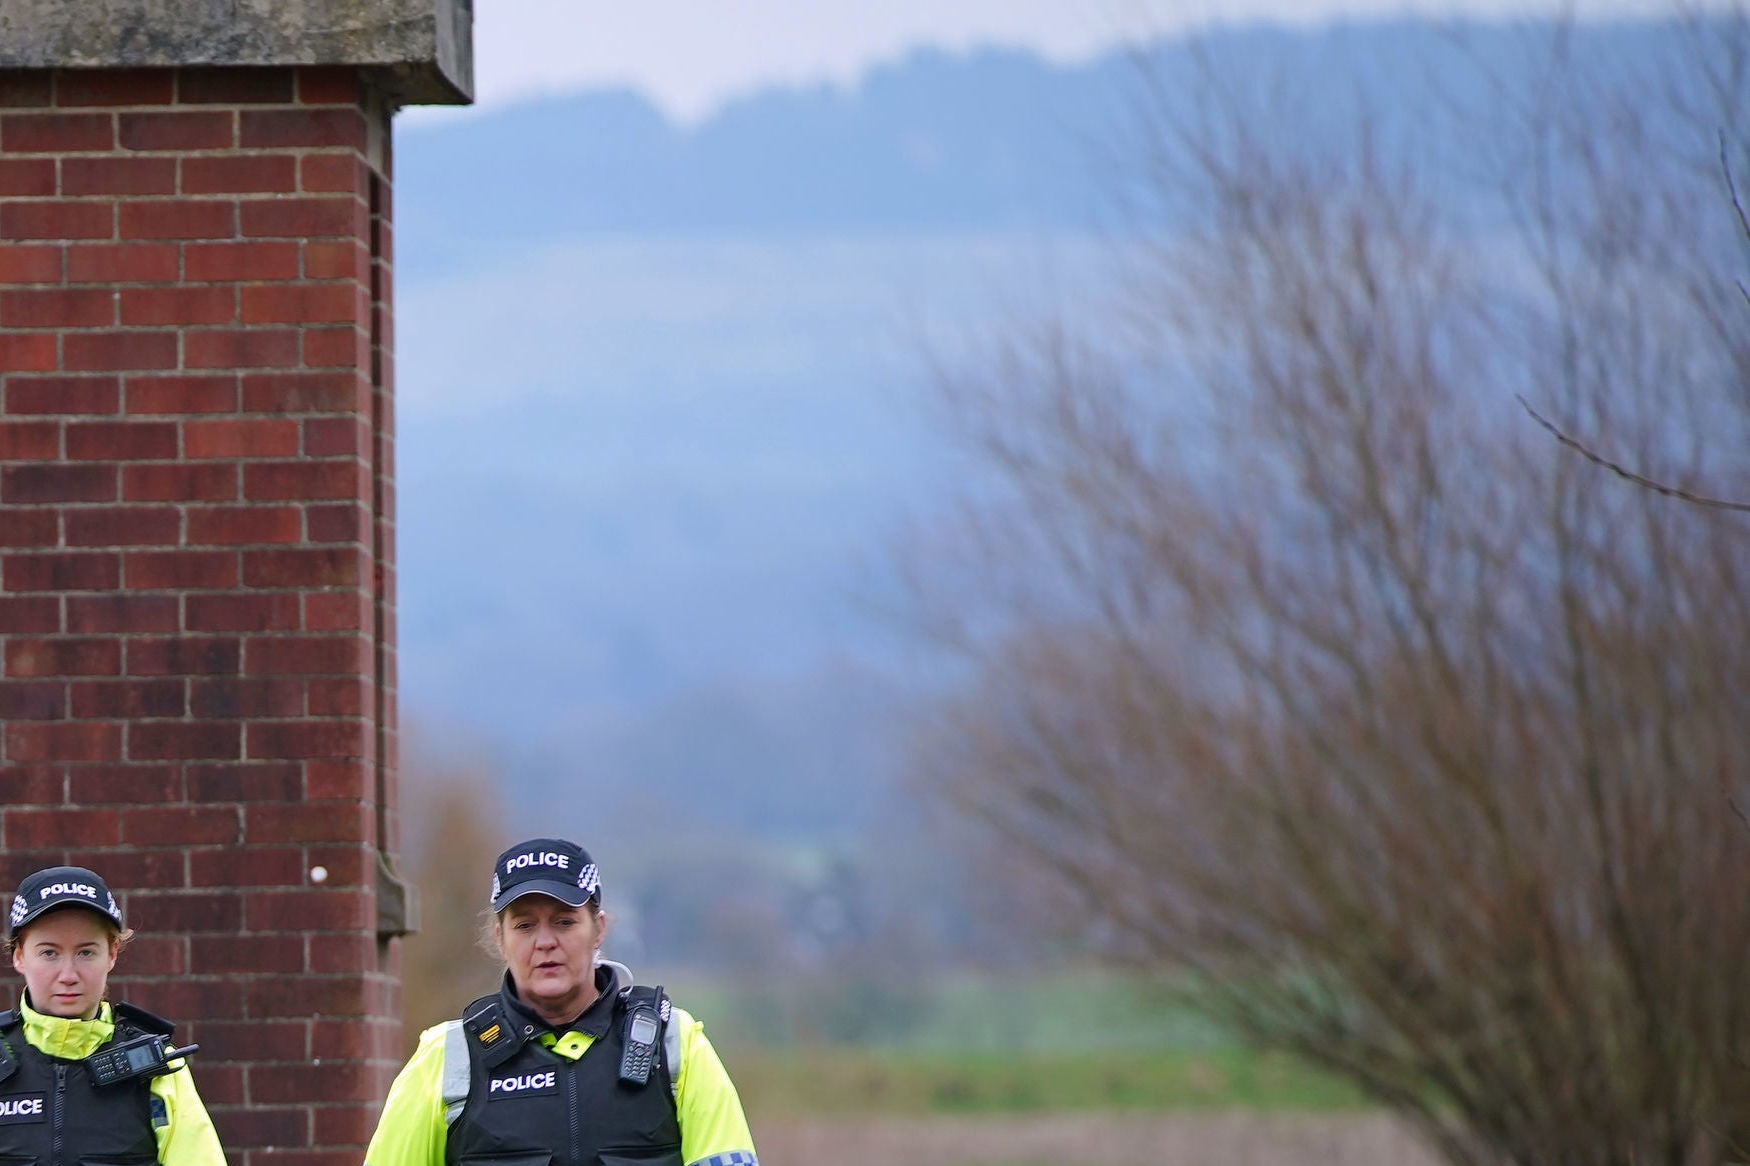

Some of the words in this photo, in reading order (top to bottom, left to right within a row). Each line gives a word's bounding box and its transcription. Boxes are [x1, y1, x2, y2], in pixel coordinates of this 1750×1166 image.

[506, 852, 569, 874] POLICE
[40, 883, 97, 900] POLICE
[490, 1071, 555, 1093] POLICE
